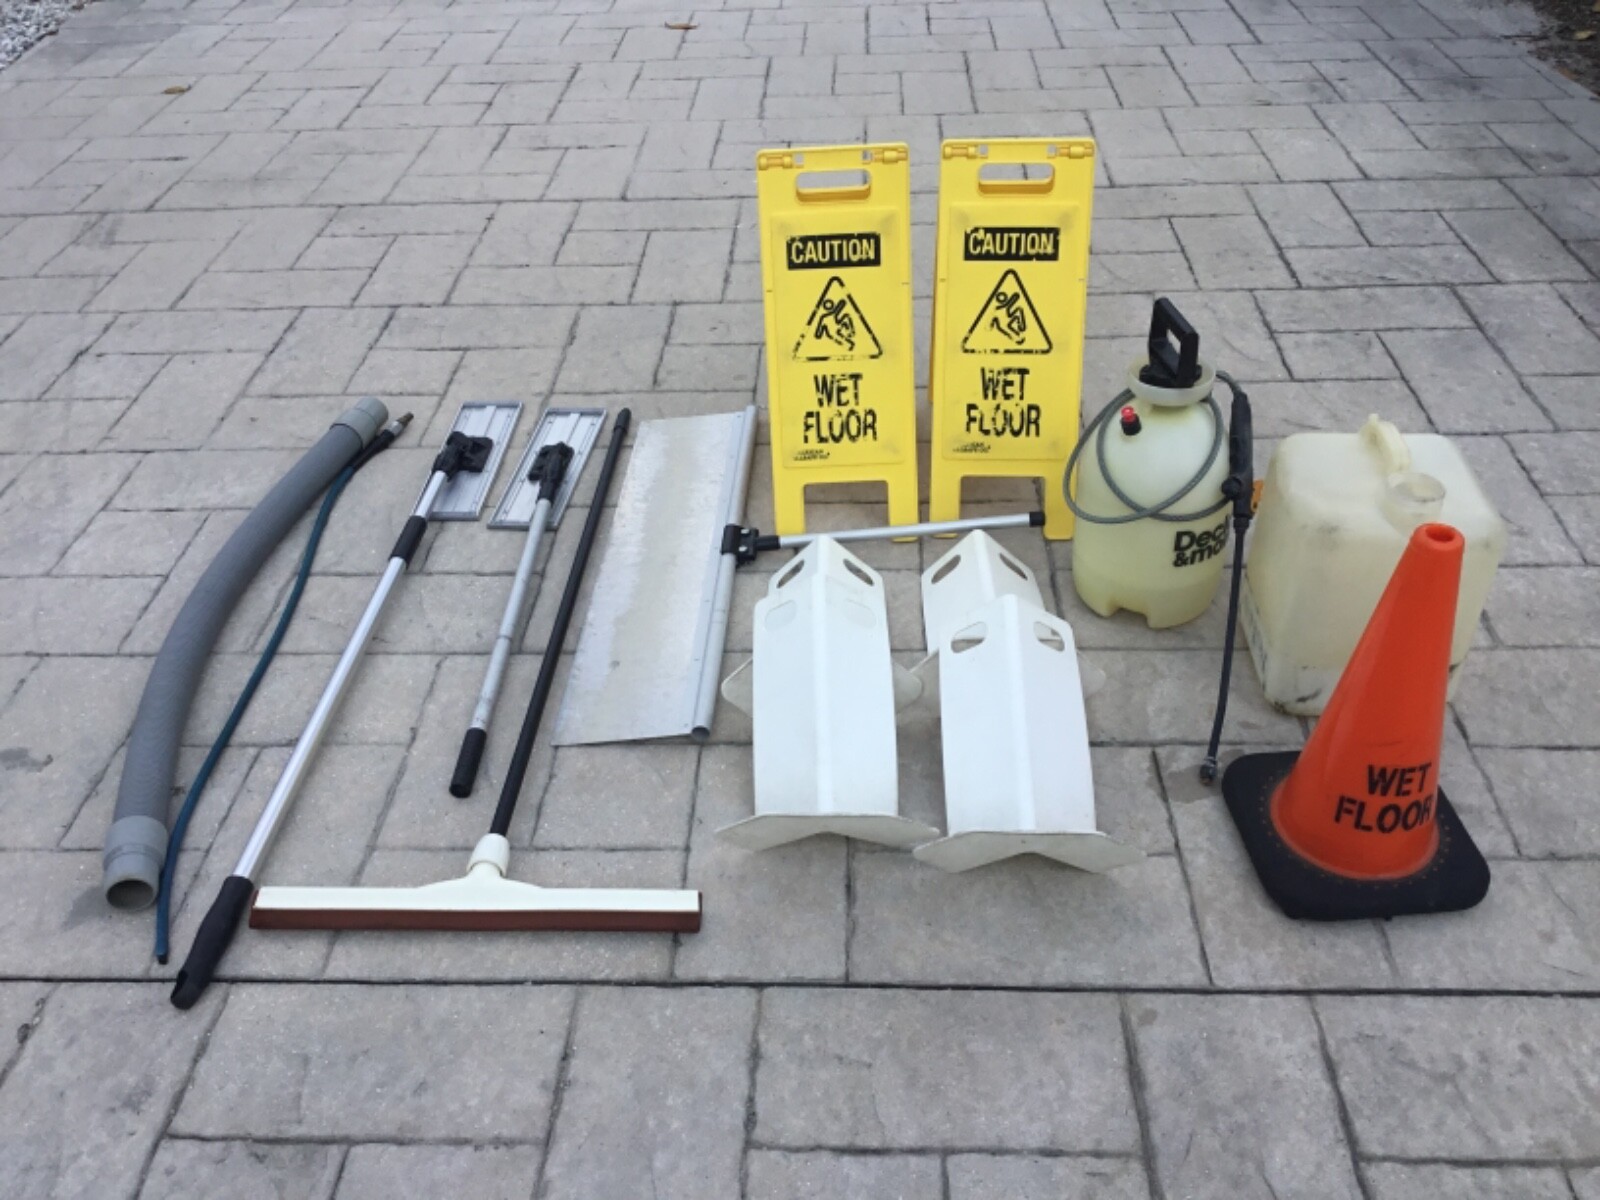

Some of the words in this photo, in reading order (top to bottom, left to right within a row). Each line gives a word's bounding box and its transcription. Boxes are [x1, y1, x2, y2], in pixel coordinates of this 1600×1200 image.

[791, 238, 876, 264] CAUTION
[968, 232, 1055, 256] CAUTION
[813, 372, 863, 407] WET
[980, 367, 1030, 401] WET
[803, 409, 877, 443] FLOOR
[965, 403, 1041, 437] FLOOR
[1174, 514, 1229, 552] Dec
[1367, 763, 1431, 797] WET
[1334, 795, 1433, 834] FLOOR
